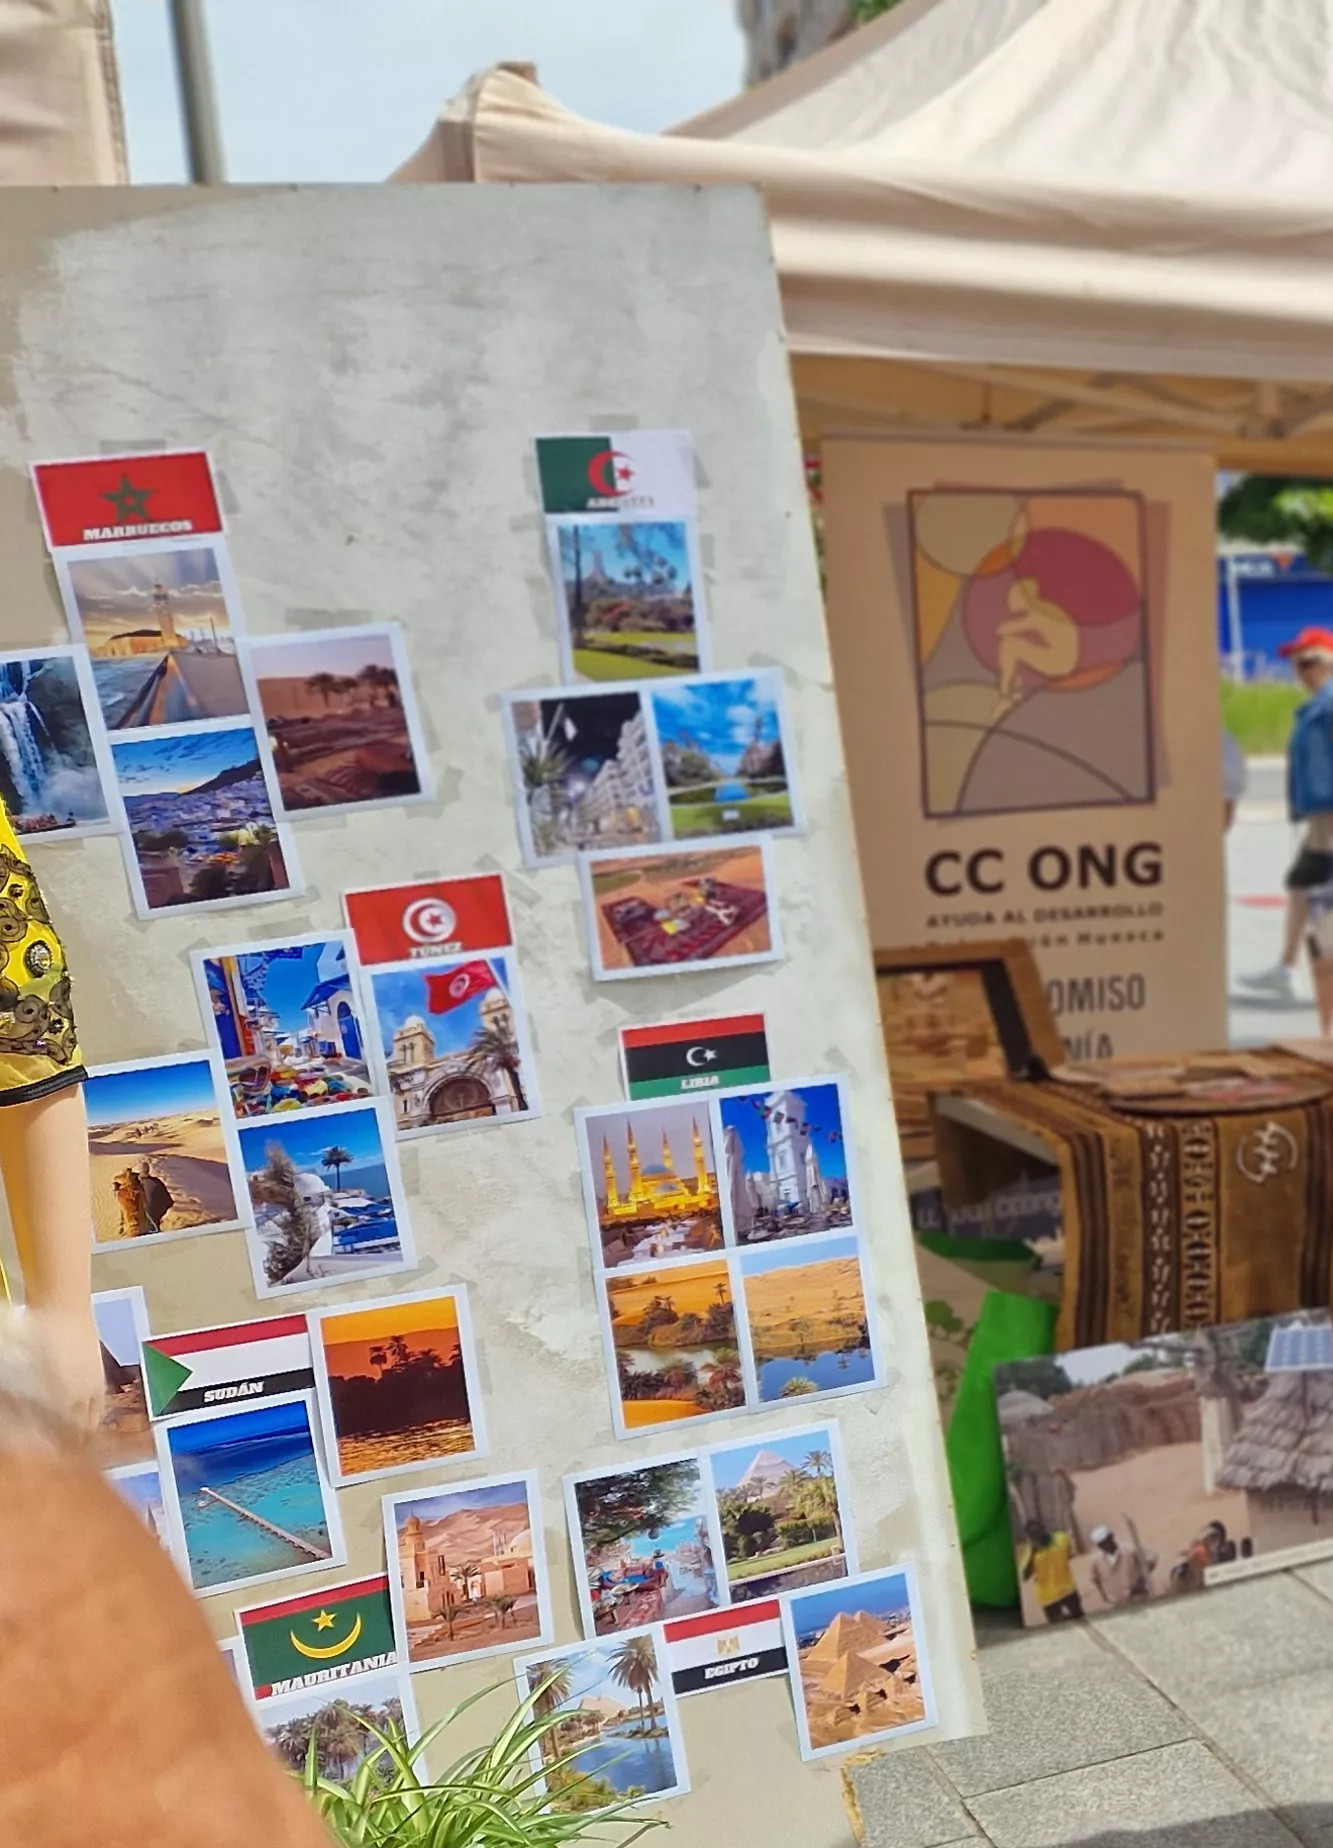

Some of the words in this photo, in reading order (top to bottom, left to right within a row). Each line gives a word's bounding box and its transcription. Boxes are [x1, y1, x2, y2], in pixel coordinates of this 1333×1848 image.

[83, 520, 193, 541] MARRUECOS
[924, 847, 1005, 897] CC
[1027, 841, 1163, 892] ONG
[926, 910, 995, 929] AYUDA
[1003, 909, 1027, 925] AL
[1033, 902, 1164, 924] DESARROLLO
[1045, 973, 1146, 1017] OMISO
[203, 1380, 264, 1403] SUDÁN
[270, 1651, 398, 1697] MAURITANIA
[704, 1657, 759, 1680] EGIPTO
